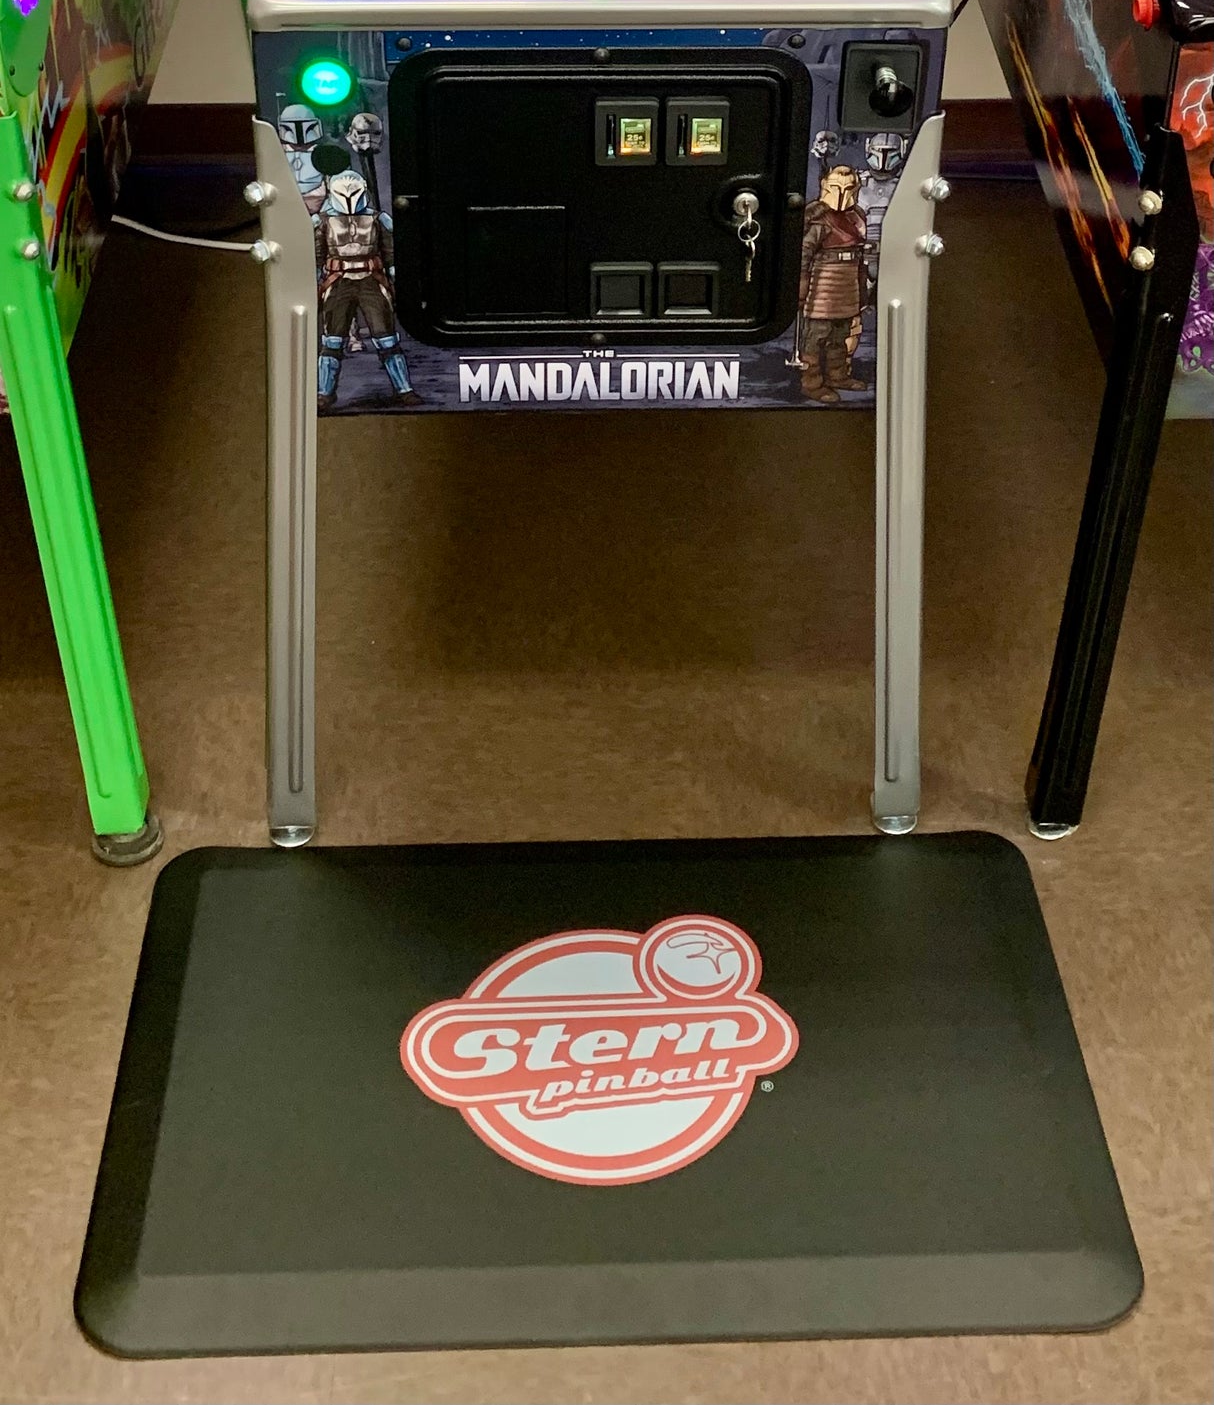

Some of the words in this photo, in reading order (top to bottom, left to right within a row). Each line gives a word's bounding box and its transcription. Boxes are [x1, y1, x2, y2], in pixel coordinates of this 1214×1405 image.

[582, 349, 614, 358] THE
[459, 361, 740, 403] MANDALORIAN
[453, 1017, 746, 1078] Stern
[540, 1058, 730, 1103] pinball
